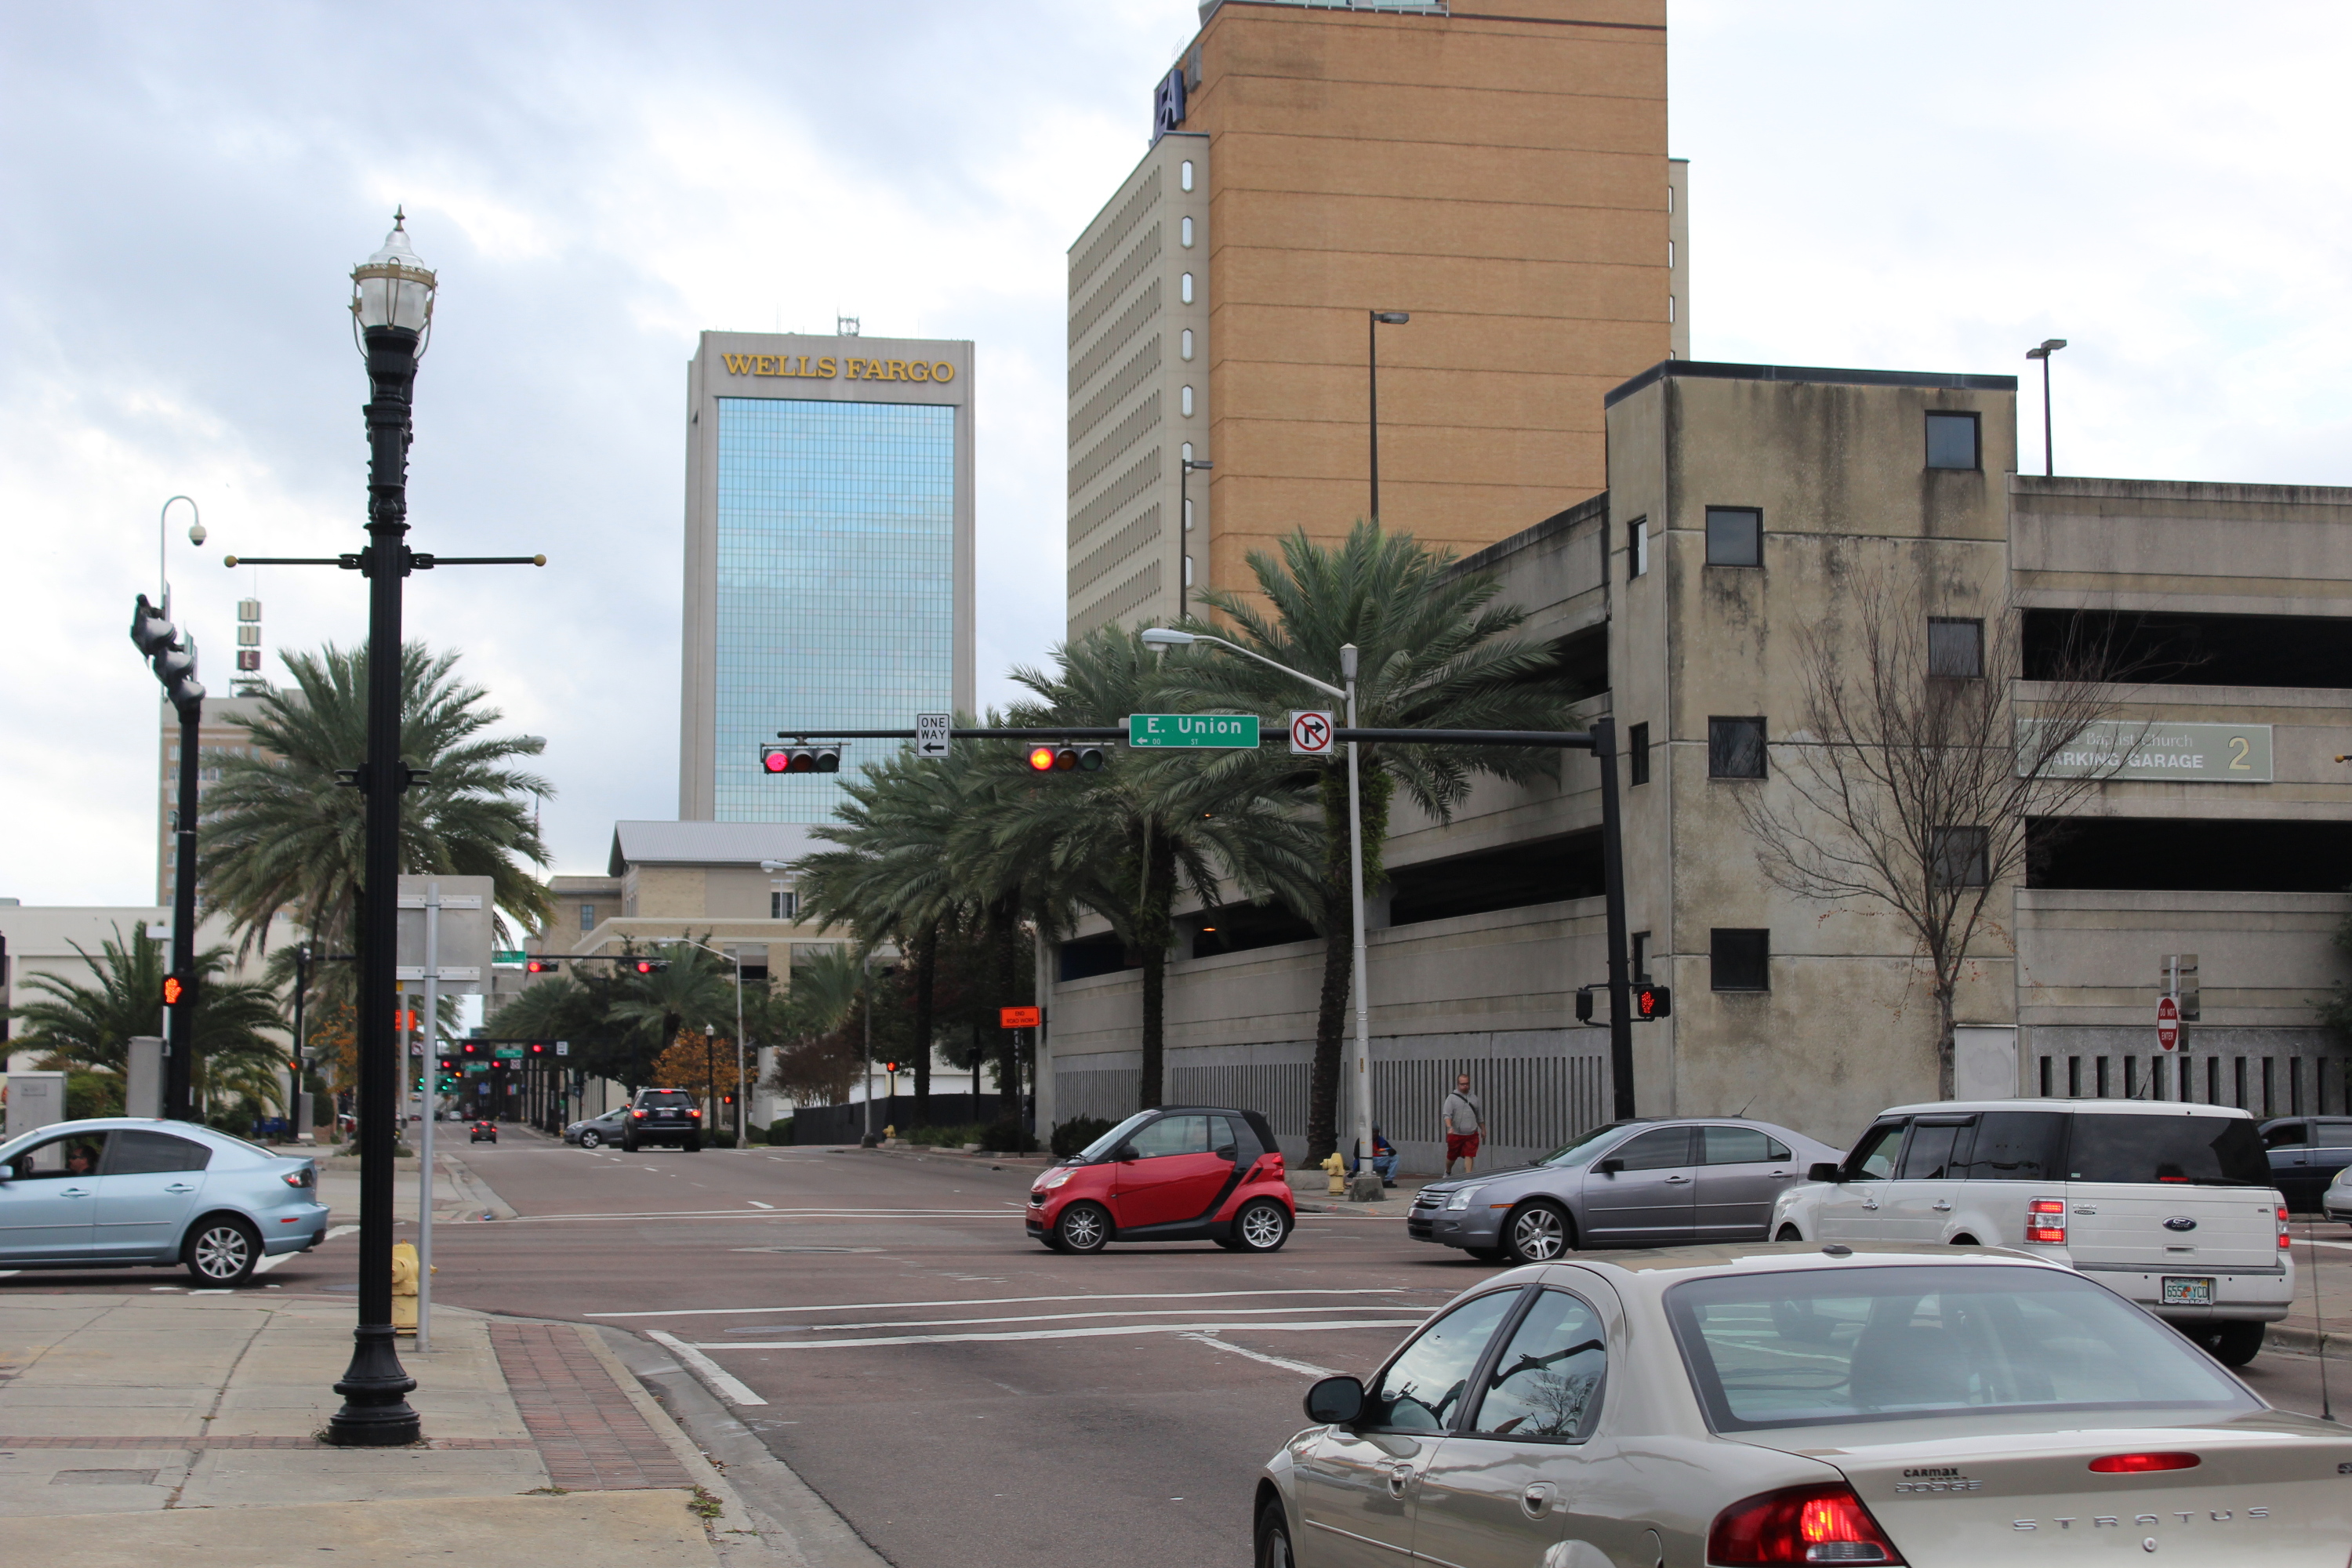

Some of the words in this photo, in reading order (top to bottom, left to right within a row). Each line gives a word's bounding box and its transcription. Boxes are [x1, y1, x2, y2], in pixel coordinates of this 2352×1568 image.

[721, 353, 837, 379] WELLS
[844, 357, 955, 383] FARGO
[921, 717, 946, 728] ONE
[1147, 717, 1166, 734] E.
[1178, 717, 1242, 734] Union
[920, 729, 946, 740] WAY
[2141, 732, 2193, 748] Church
[2227, 735, 2251, 770] 2
[2040, 751, 2120, 768] ARKING
[2129, 753, 2204, 768] GARAGE
[2159, 1008, 2166, 1017] DO
[2167, 1008, 2176, 1017] NOT
[2161, 1032, 2174, 1040] ENTER
[2172, 1218, 2190, 1228] Ford
[2167, 1285, 2182, 1298] 655
[1896, 1480, 1983, 1492] DODGE
[2013, 1506, 2269, 1530] STRATUS
